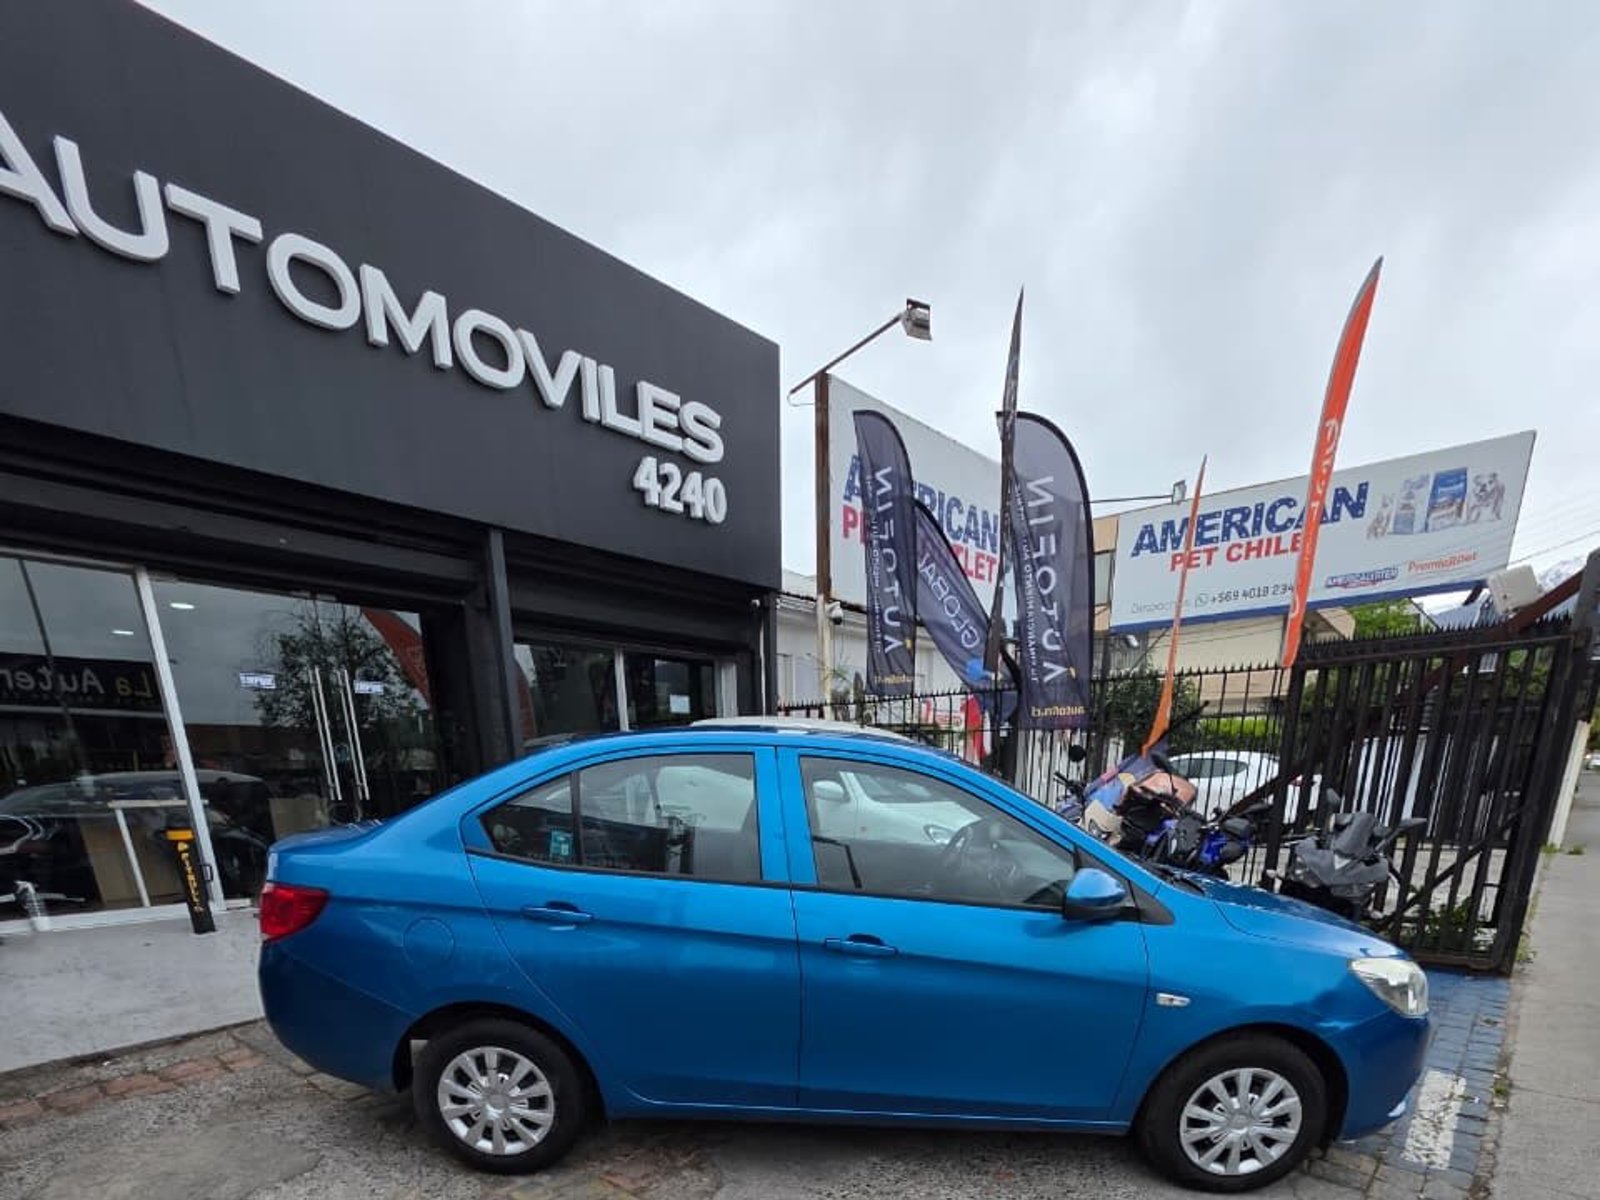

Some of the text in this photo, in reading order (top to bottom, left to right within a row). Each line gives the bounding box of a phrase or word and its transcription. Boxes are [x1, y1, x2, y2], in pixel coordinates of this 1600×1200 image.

[0, 111, 724, 462] AUTOMOVILES
[633, 456, 727, 525] 4240
[1170, 532, 1302, 571] PET CHILE
[1272, 583, 1294, 596] 234
